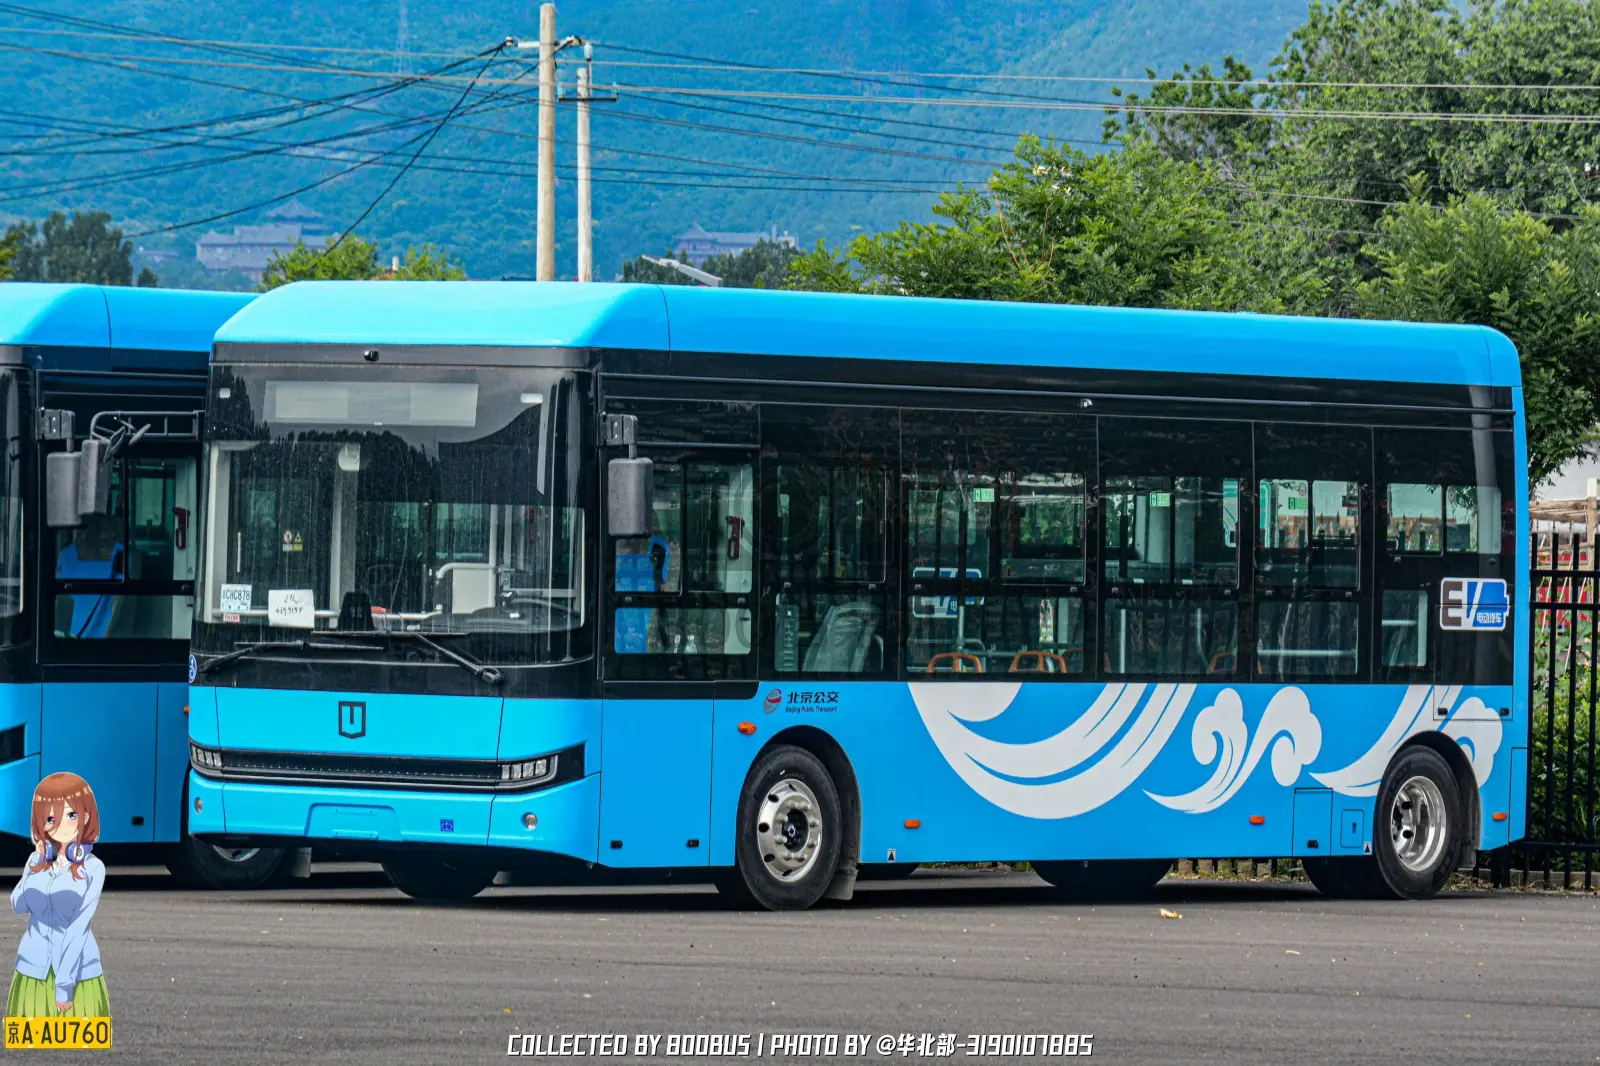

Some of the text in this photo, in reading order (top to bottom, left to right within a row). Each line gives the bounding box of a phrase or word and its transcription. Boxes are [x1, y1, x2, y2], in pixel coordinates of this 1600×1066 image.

[1442, 579, 1484, 628] EV
[1476, 612, 1502, 624] 电动汽车
[786, 691, 840, 704] 北京公交
[785, 706, 800, 714] Beijing
[815, 706, 838, 714] Transport
